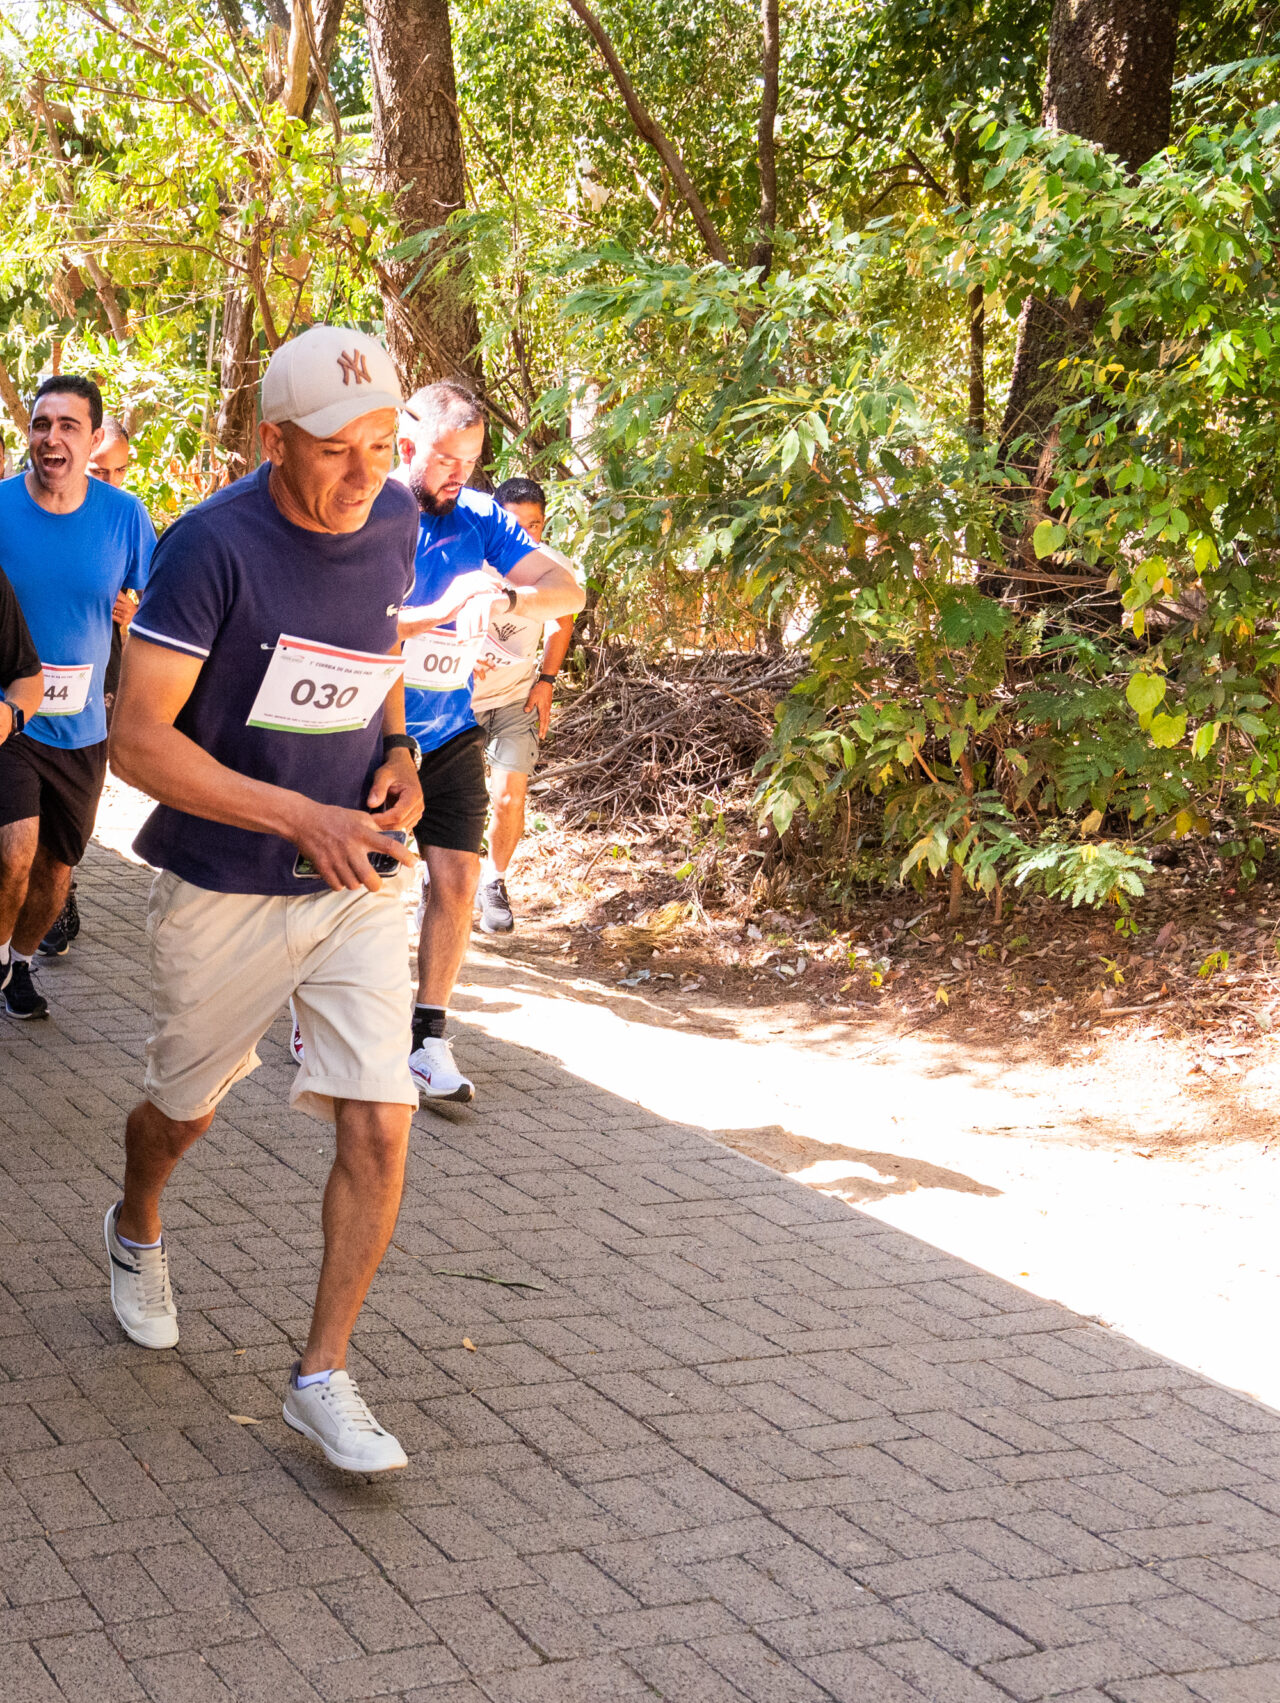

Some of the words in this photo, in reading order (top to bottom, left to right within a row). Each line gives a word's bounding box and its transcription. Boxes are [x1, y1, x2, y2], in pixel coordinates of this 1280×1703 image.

[423, 654, 461, 674] 001
[44, 685, 68, 700] 44
[290, 679, 359, 709] 030
